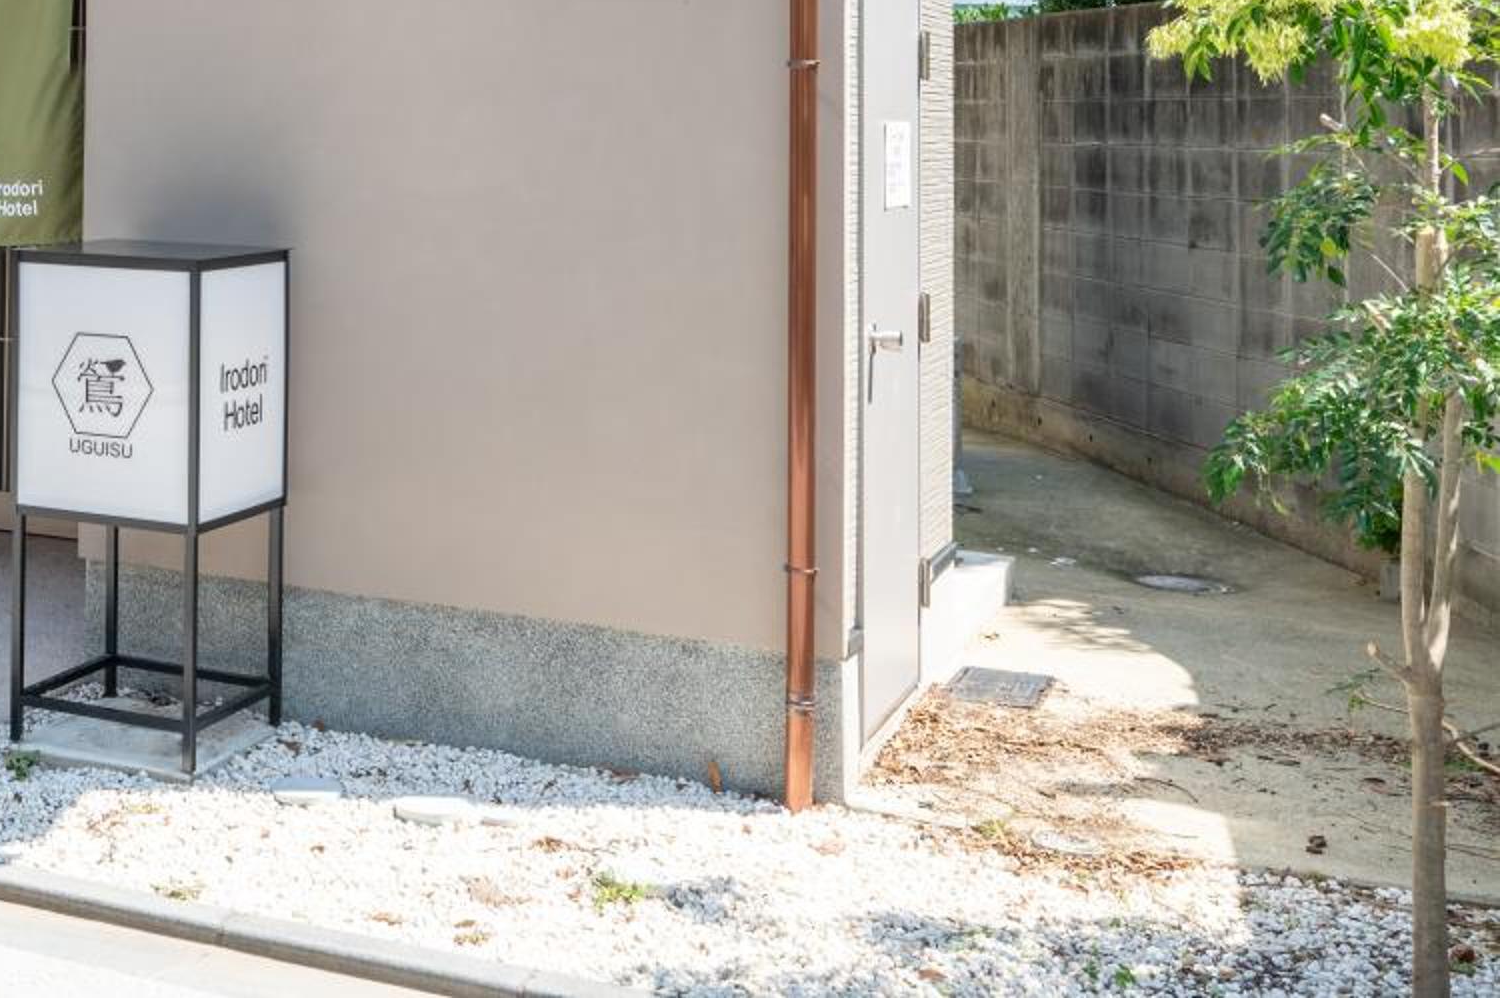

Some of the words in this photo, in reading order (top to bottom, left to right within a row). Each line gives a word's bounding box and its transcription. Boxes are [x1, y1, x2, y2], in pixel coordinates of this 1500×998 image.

[219, 354, 269, 394] Irodori
[223, 392, 263, 432] Hotel
[69, 437, 133, 459] UGUISU
